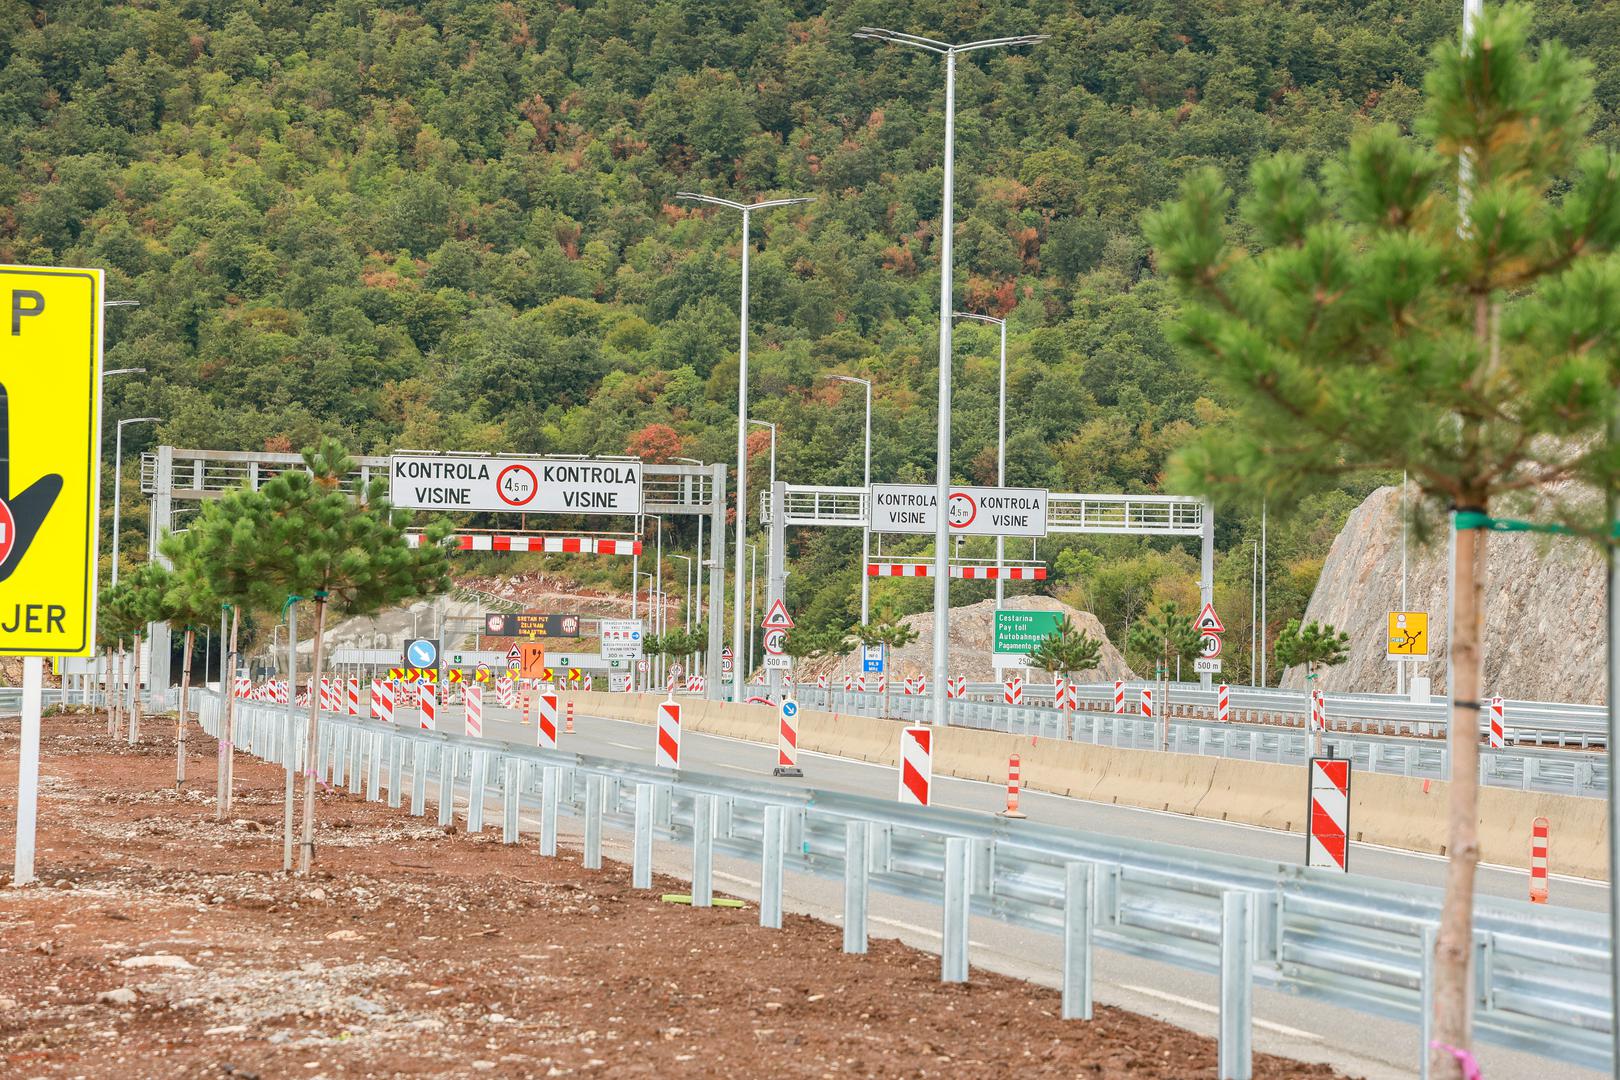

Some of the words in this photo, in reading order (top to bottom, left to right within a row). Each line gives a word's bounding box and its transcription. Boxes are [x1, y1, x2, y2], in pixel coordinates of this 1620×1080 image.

[395, 461, 490, 480] KONTROLA
[544, 465, 637, 484] KONTROLA
[504, 477, 519, 492] 4,5
[521, 483, 528, 492] m
[415, 487, 471, 504] VISINE
[563, 491, 618, 508] VISINE
[877, 493, 937, 507] KONTROLA
[980, 496, 1040, 510] KONTROLA
[950, 504, 962, 517] 4,5
[889, 511, 926, 524] VISINE
[992, 514, 1029, 527] VISINE
[998, 614, 1033, 622] Cestarina
[998, 623, 1012, 631] Pay
[1014, 623, 1027, 631] toll
[998, 633, 1049, 642] Autobahngeb
[998, 641, 1032, 650] Pagamento
[767, 658, 780, 666] 500
[1197, 661, 1211, 670] 500
